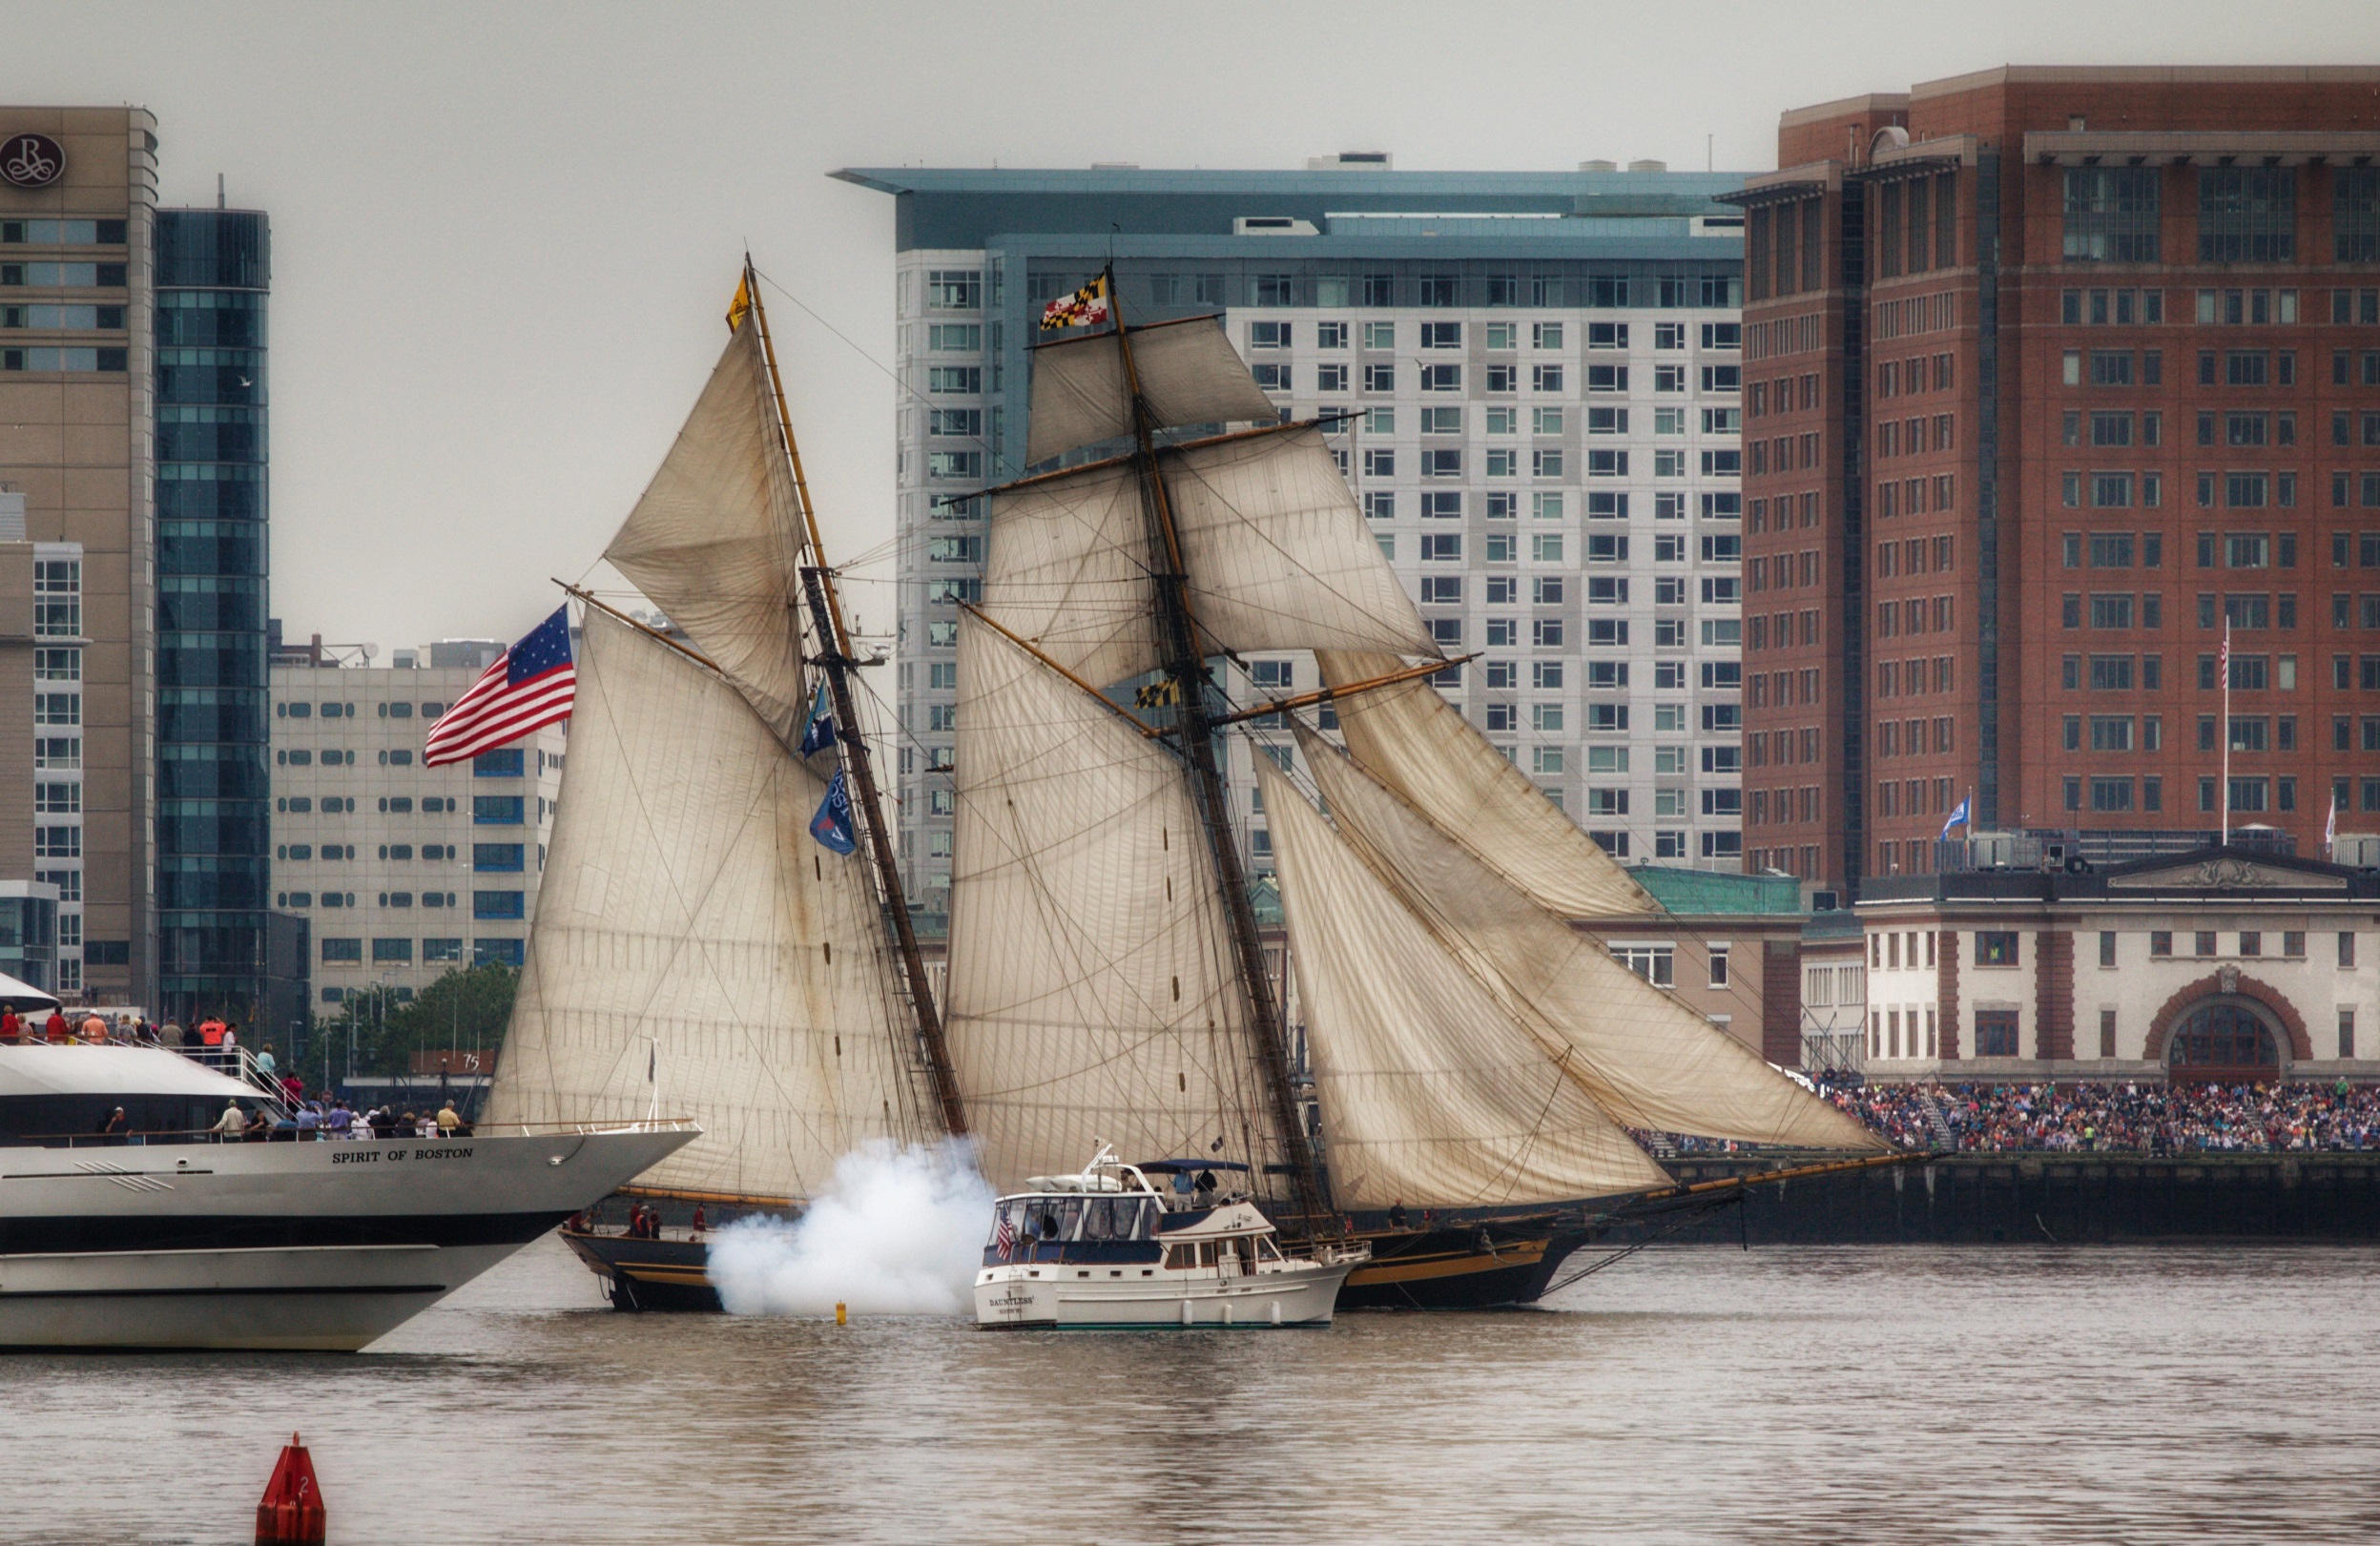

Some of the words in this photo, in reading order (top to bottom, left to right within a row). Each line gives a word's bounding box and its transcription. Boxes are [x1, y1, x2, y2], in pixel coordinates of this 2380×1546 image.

[463, 1054, 479, 1071] 75
[333, 1151, 380, 1164] SPIRIT
[387, 1150, 406, 1161] OF
[415, 1148, 473, 1160] BOSTON
[300, 1475, 309, 1493] 2
